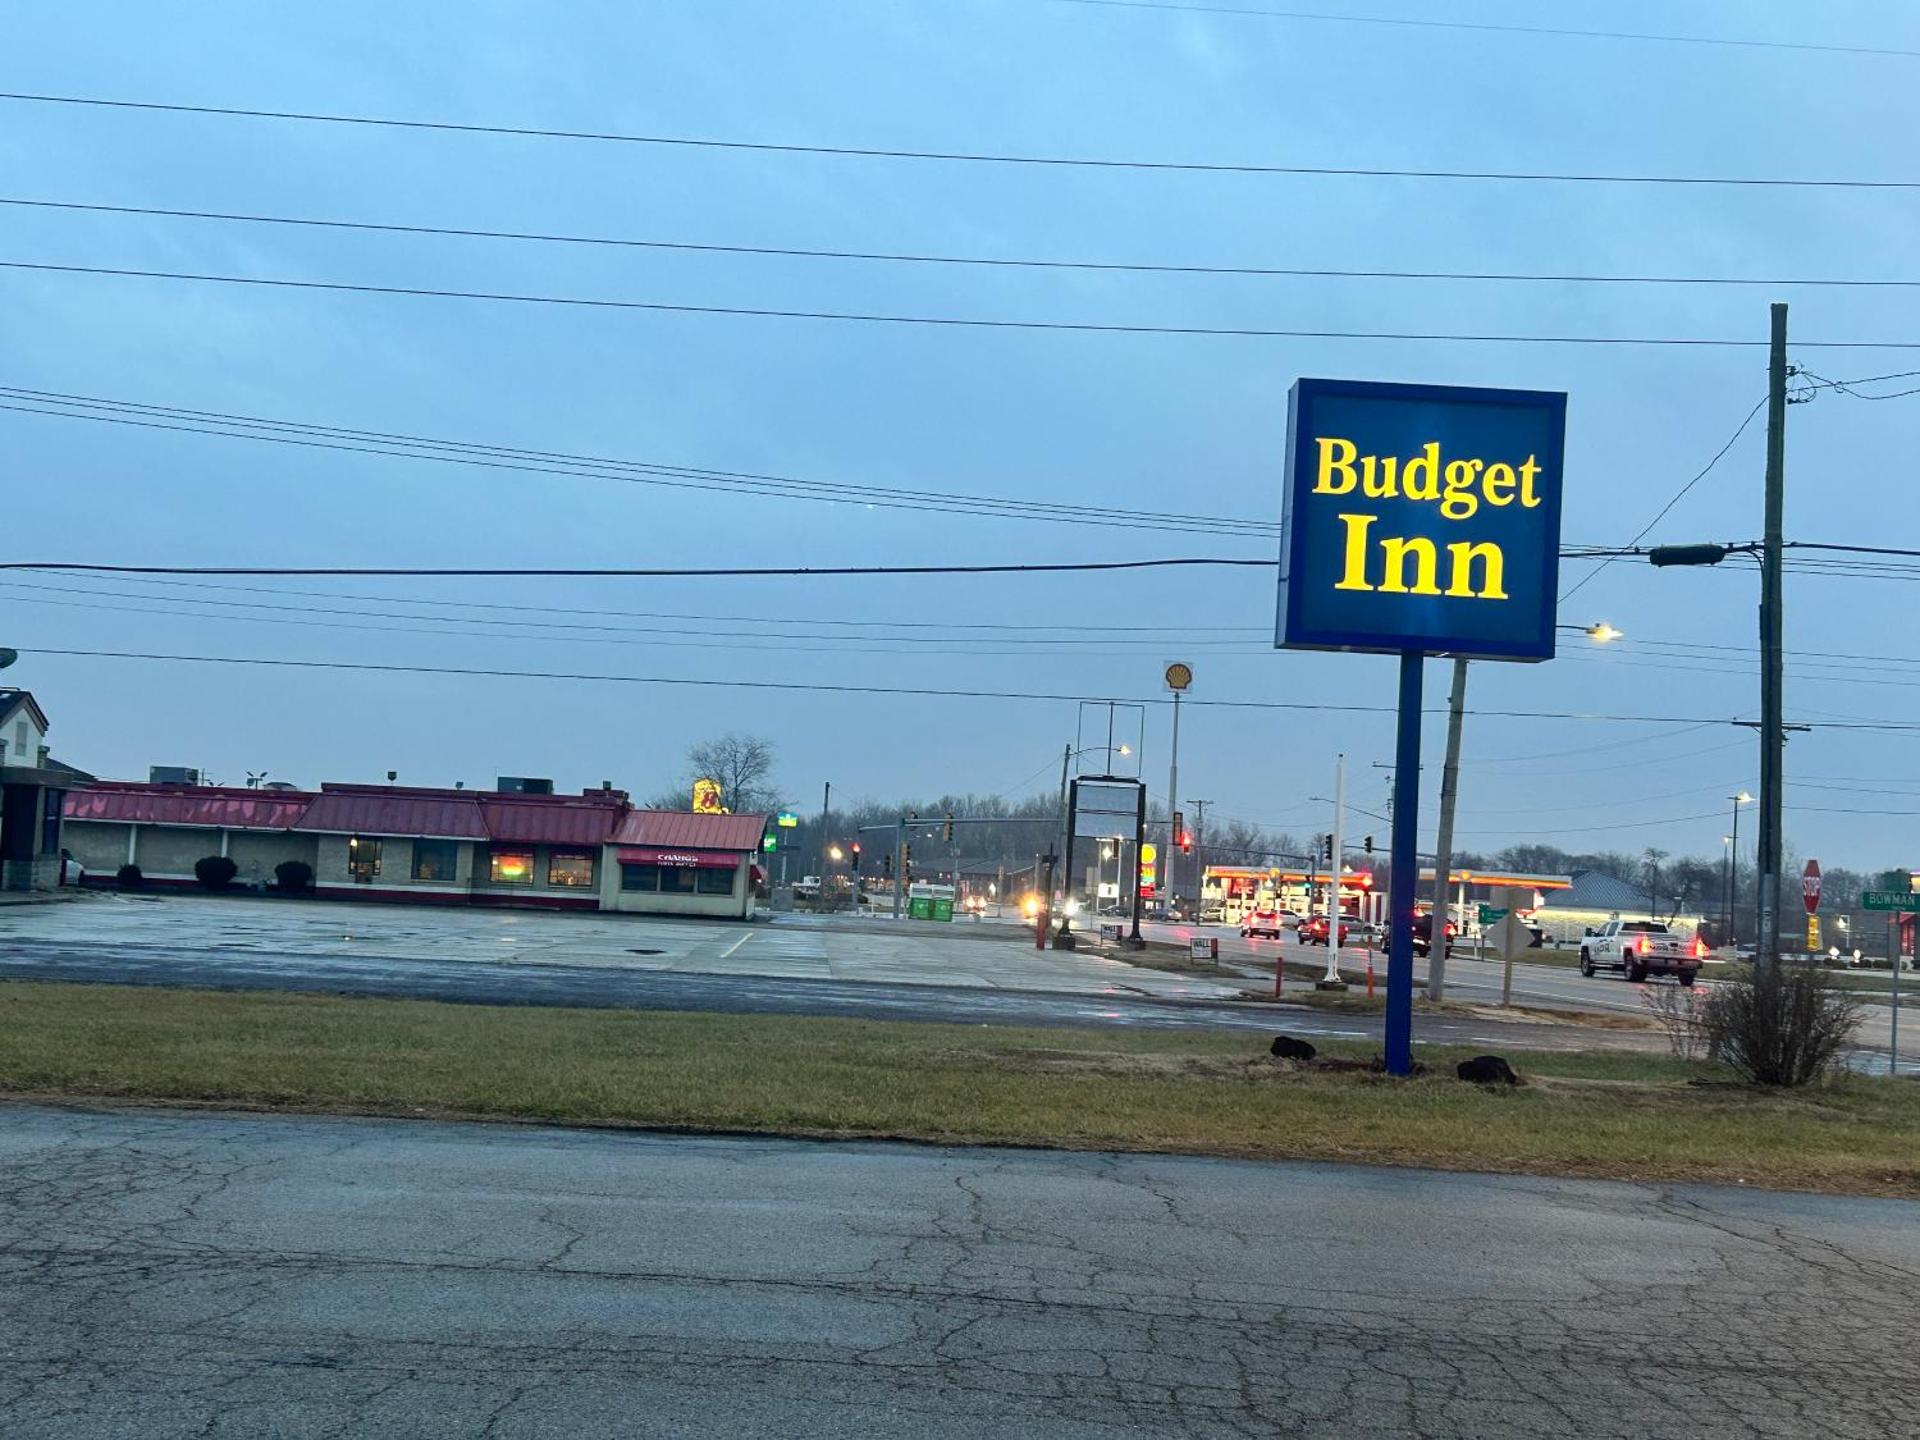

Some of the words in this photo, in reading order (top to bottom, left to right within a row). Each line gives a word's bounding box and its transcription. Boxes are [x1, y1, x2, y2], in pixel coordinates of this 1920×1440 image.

[1312, 438, 1541, 519] Budget
[1334, 514, 1508, 599] Inn
[1803, 877, 1820, 896] STOP
[1869, 893, 1915, 905] BOWMAN
